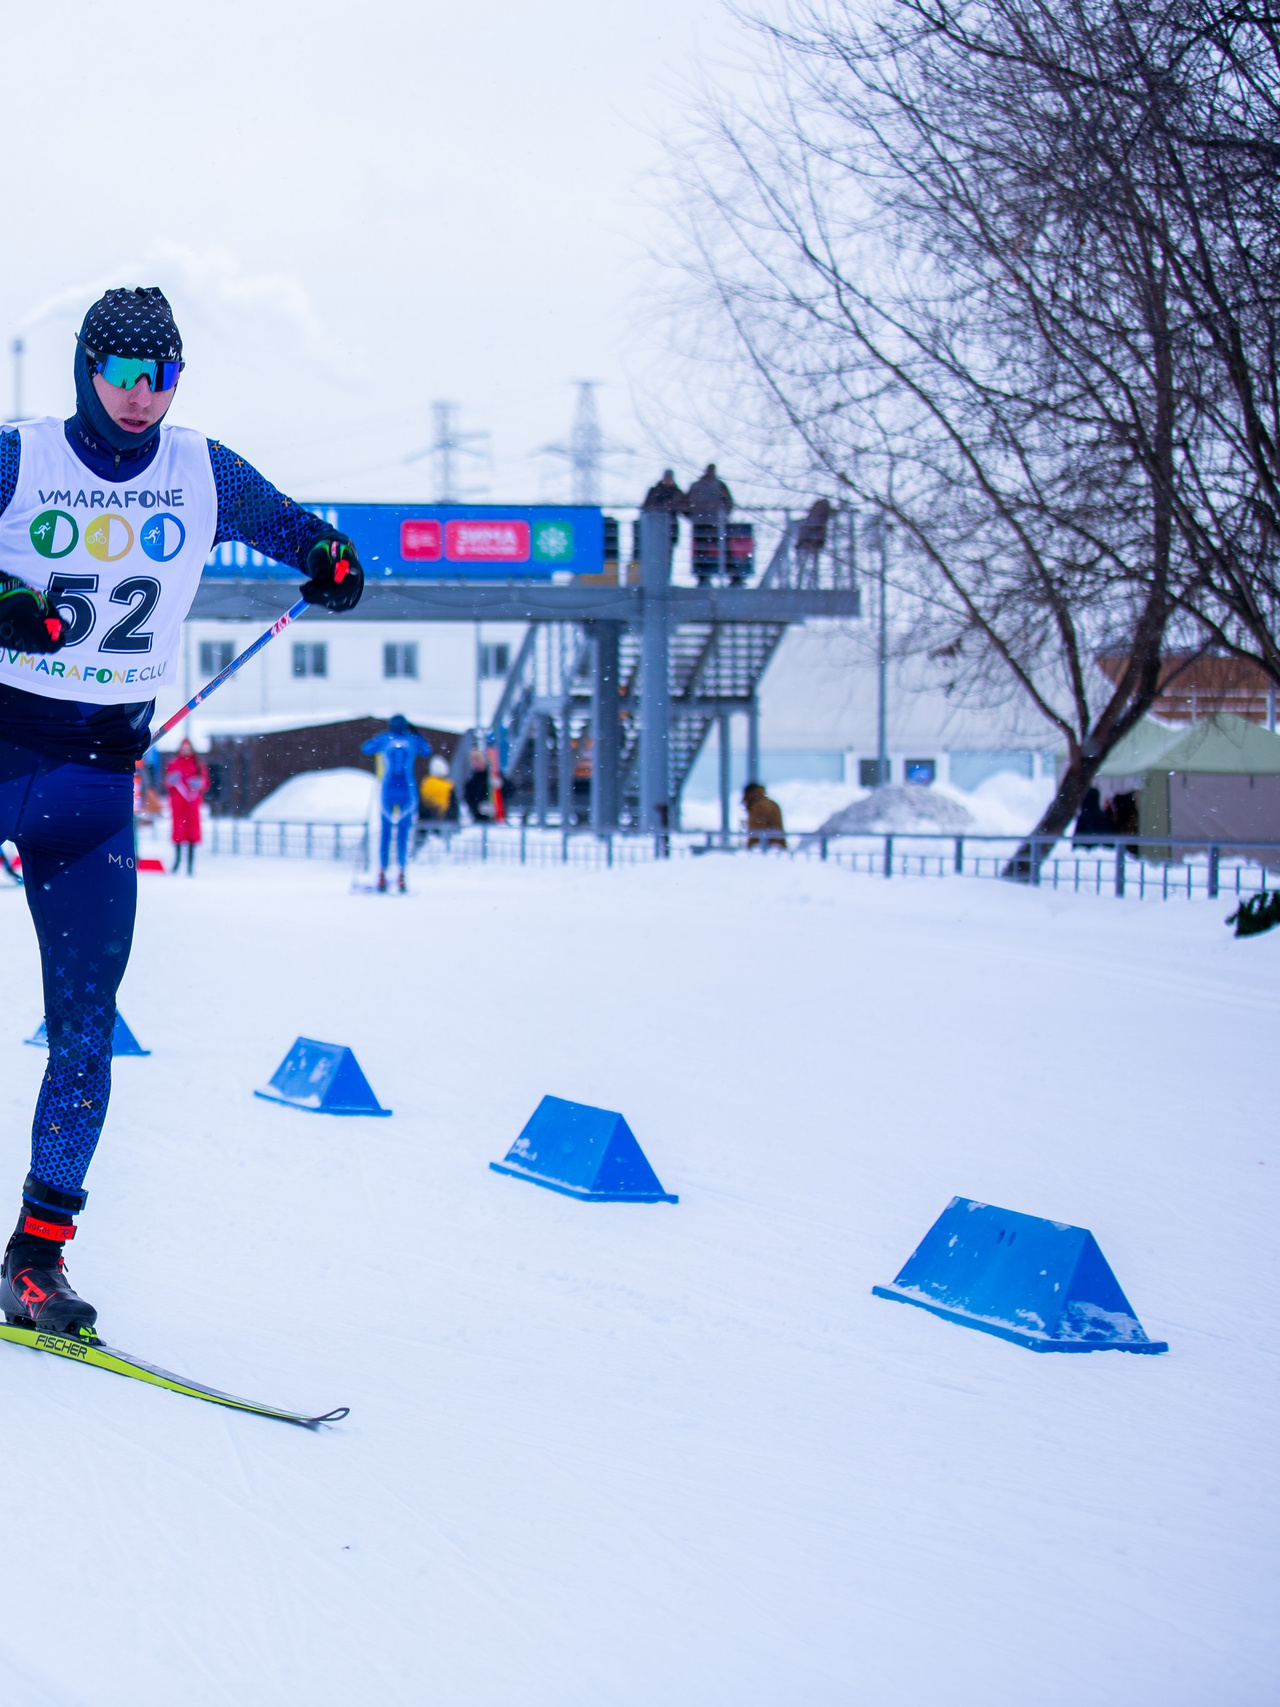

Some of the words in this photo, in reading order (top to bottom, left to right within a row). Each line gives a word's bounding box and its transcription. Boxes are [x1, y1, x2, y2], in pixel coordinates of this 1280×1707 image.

[38, 489, 185, 508] VMARAFONE
[43, 572, 162, 654] 52
[35, 1334, 88, 1360] FISCHER
